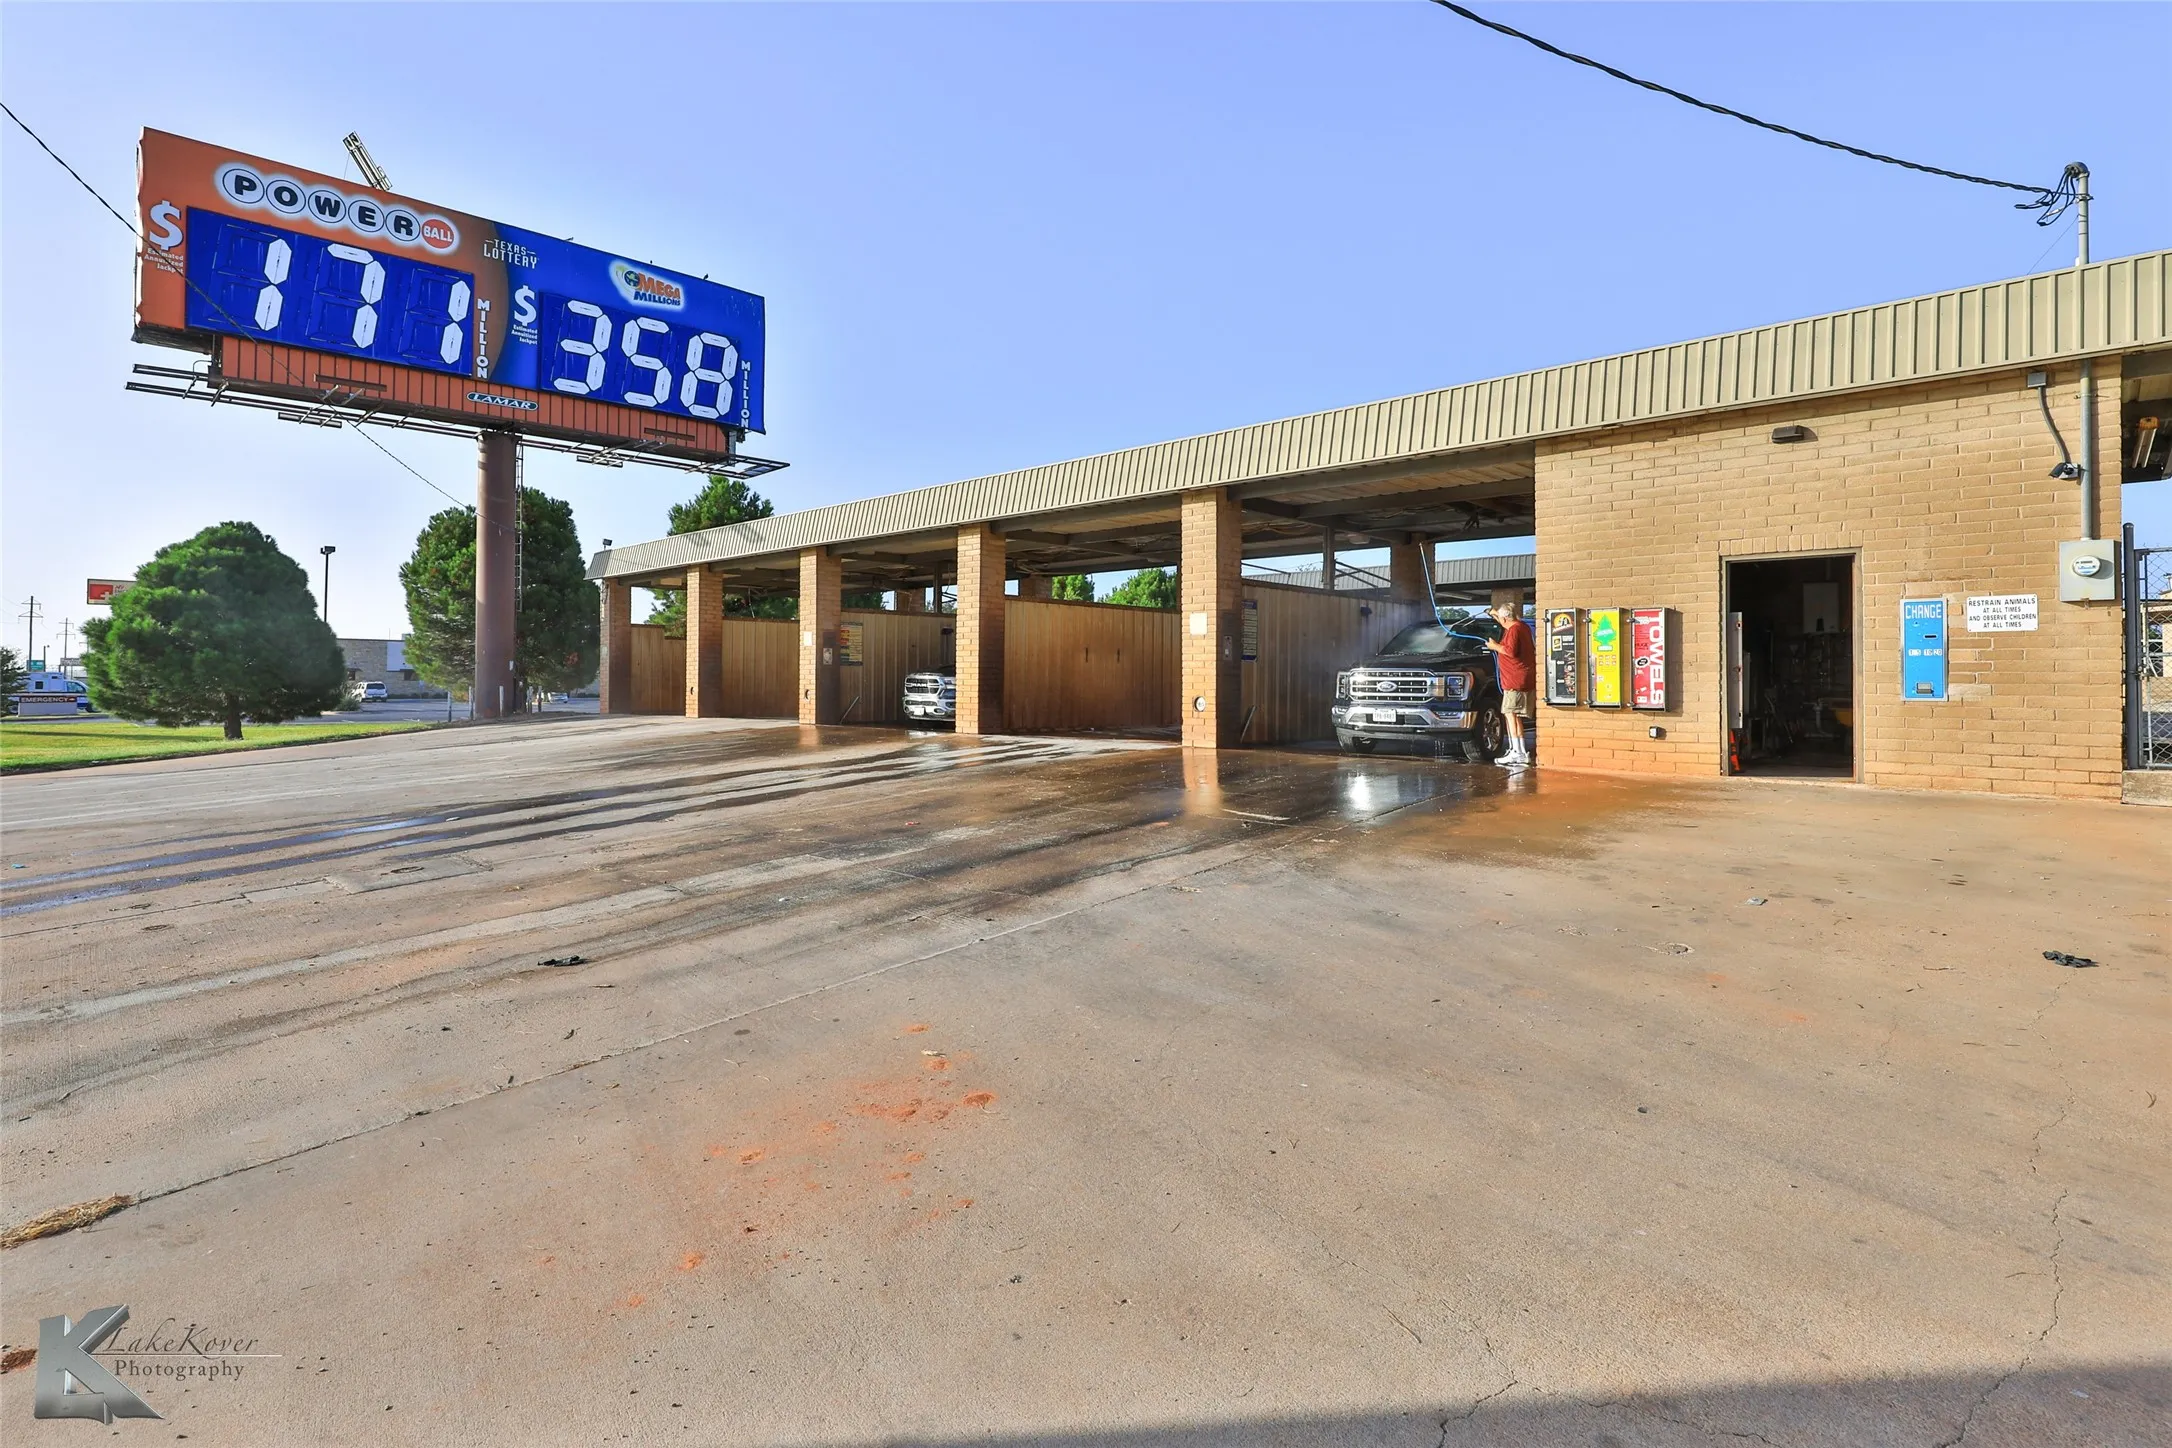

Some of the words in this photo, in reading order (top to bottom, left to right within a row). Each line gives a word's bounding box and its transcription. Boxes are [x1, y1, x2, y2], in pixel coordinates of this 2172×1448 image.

[483, 243, 537, 269] LOTTERY
[494, 239, 527, 255] TEXAS
[633, 290, 681, 306] MILLIONS
[637, 272, 681, 299] MEGA
[476, 298, 490, 379] MILLION
[553, 299, 739, 420] 358
[473, 394, 531, 409] LAMAR
[740, 360, 751, 428] MILLION
[1905, 604, 1942, 619] CHANGE
[1968, 599, 2001, 607] RESTRAIN
[1649, 611, 1664, 704] TOWELS
